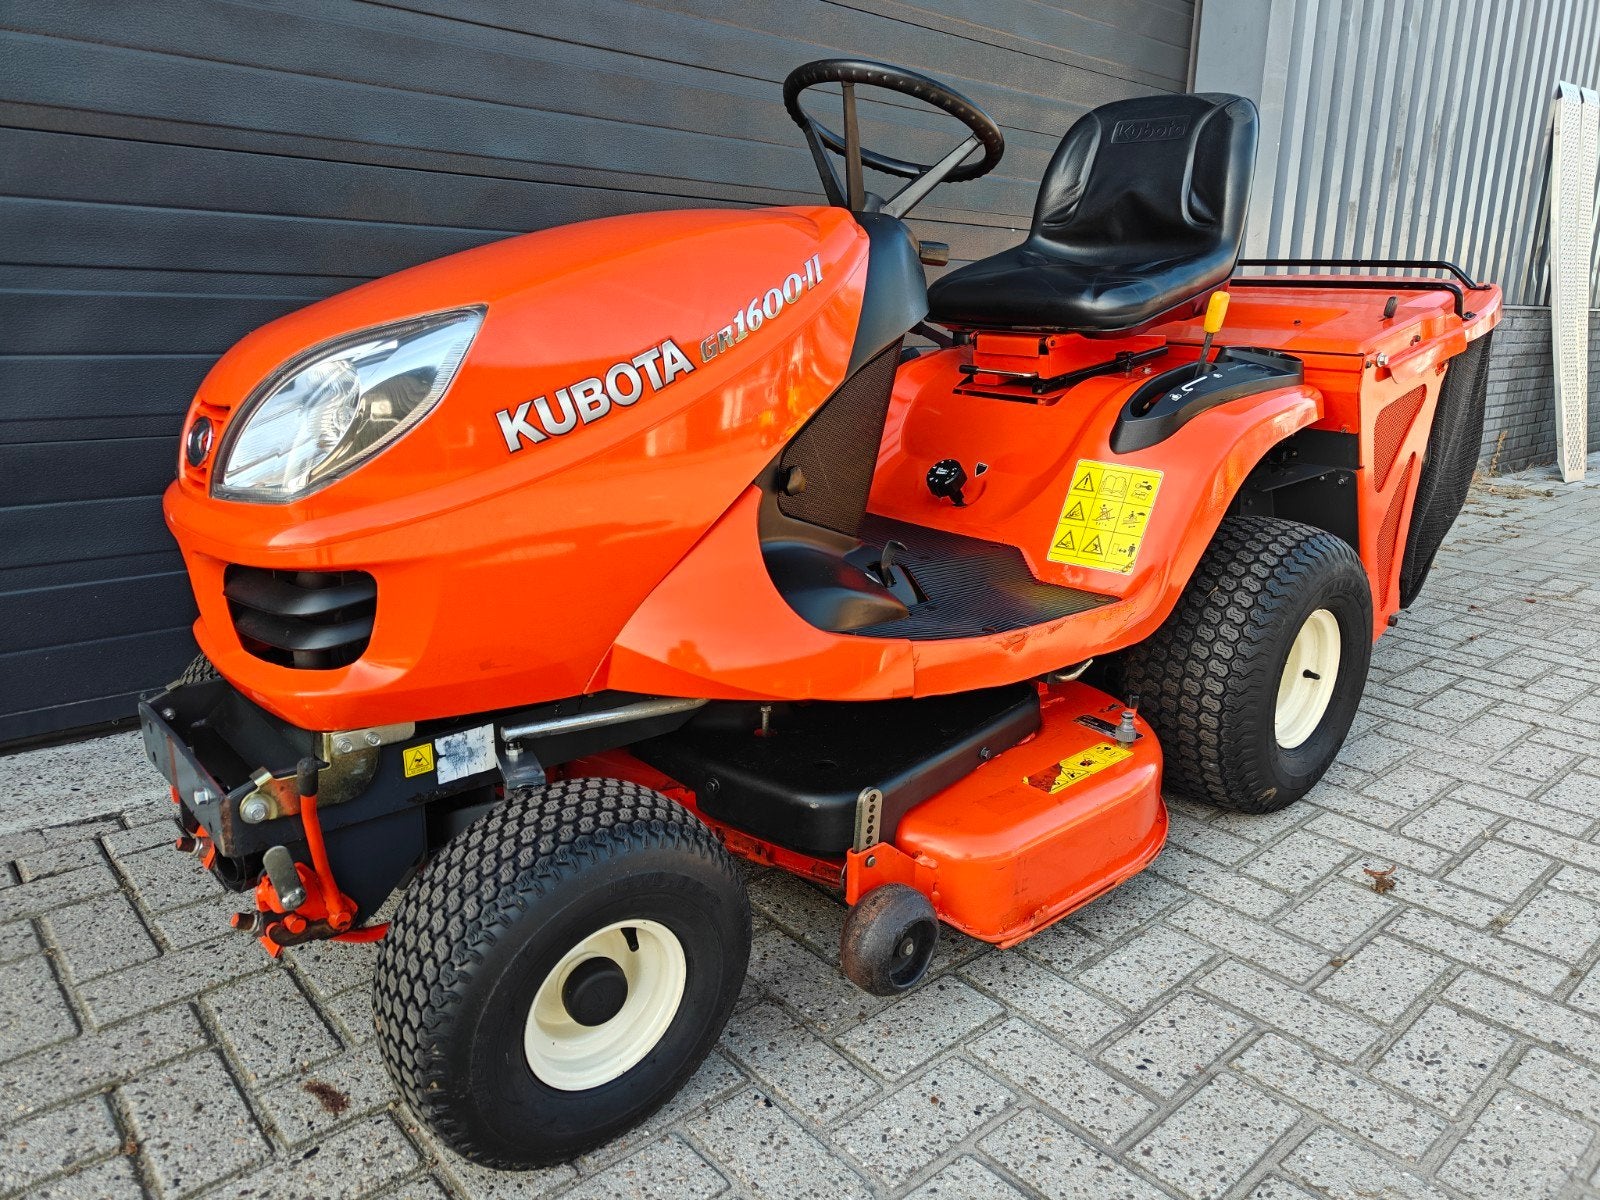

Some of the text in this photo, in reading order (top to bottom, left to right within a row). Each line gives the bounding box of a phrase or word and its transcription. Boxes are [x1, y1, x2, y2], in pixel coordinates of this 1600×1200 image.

[1118, 119, 1186, 139] Kubota
[496, 253, 824, 453] KUBOTA GR1600-II
